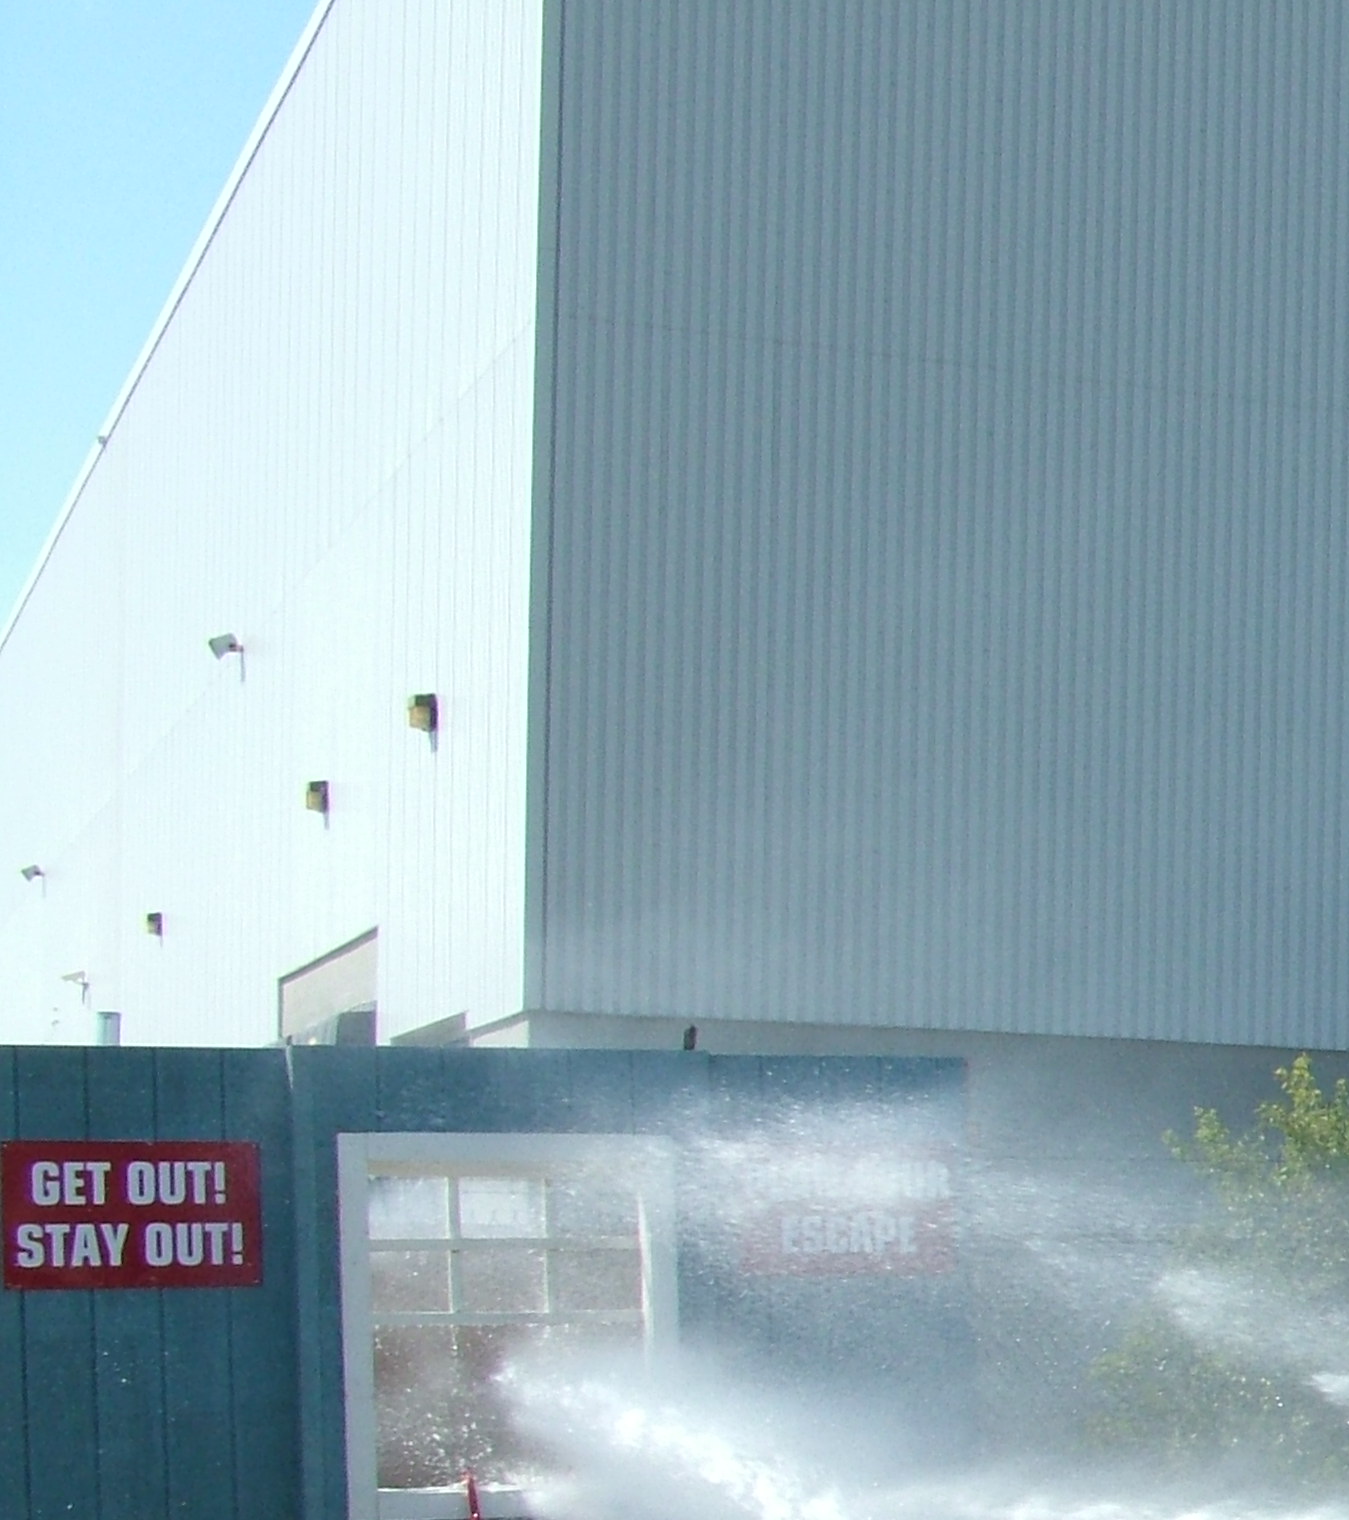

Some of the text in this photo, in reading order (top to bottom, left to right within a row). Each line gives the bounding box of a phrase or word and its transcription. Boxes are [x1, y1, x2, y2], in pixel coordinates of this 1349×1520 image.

[32, 1161, 226, 1206] GET OUT!
[17, 1222, 243, 1268] STAY OUT!
